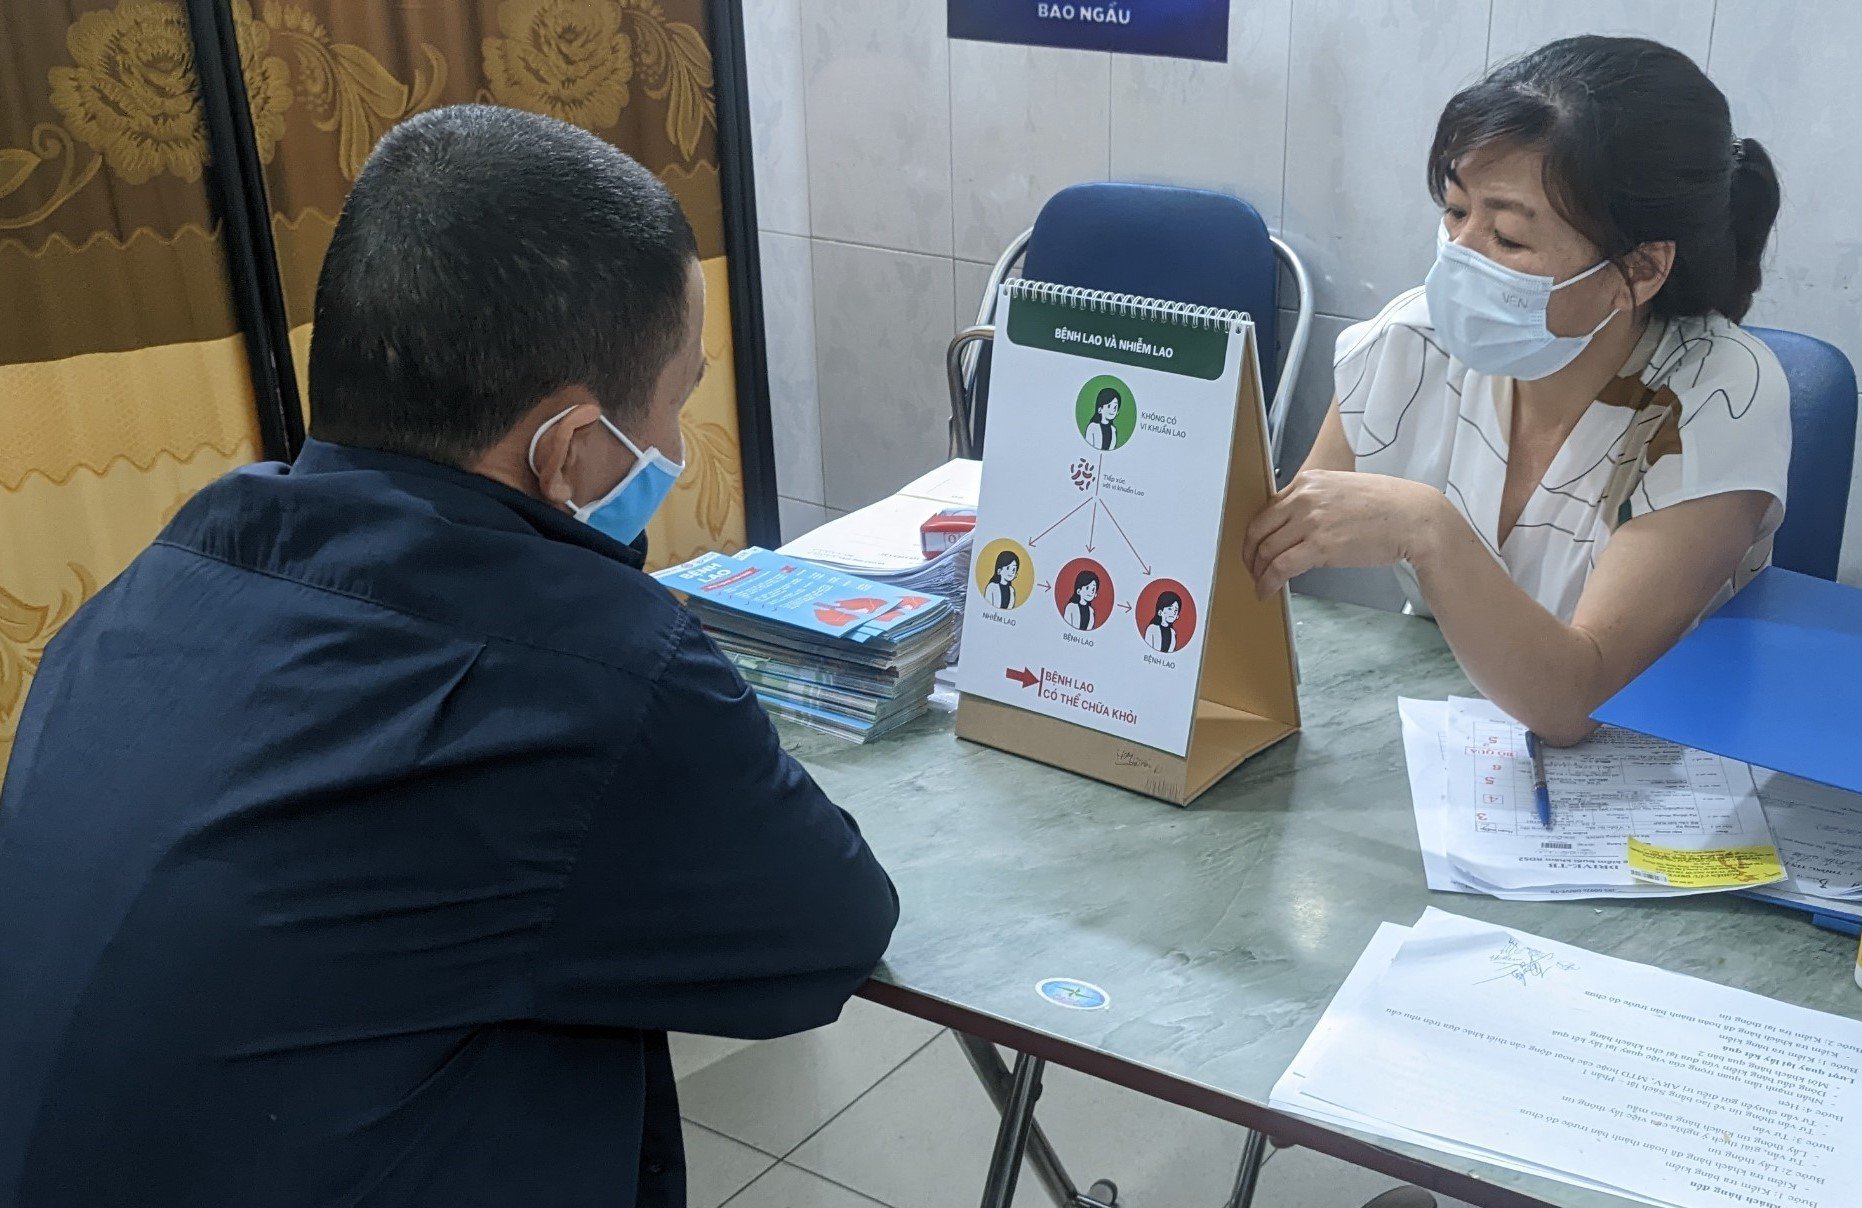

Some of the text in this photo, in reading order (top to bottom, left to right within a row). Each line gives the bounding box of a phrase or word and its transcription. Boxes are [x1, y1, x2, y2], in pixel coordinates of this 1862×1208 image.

[1037, 1, 1131, 24] BAO NGẤU
[1054, 326, 1173, 358] BỆNH LAO VÀ NHIỄM LAO
[1141, 411, 1177, 425] KHÔNG CÓ
[1148, 424, 1172, 436] KHUẨN
[1172, 430, 1187, 439] LAO
[982, 612, 1017, 627] NHIỄM LAO
[1063, 632, 1095, 648] BỆNH LAO
[1143, 654, 1176, 670] BỆNH LAO
[1045, 671, 1094, 693] BỆNH LAO
[1043, 687, 1138, 725] CÓ THỂ CHỮA KHỎI
